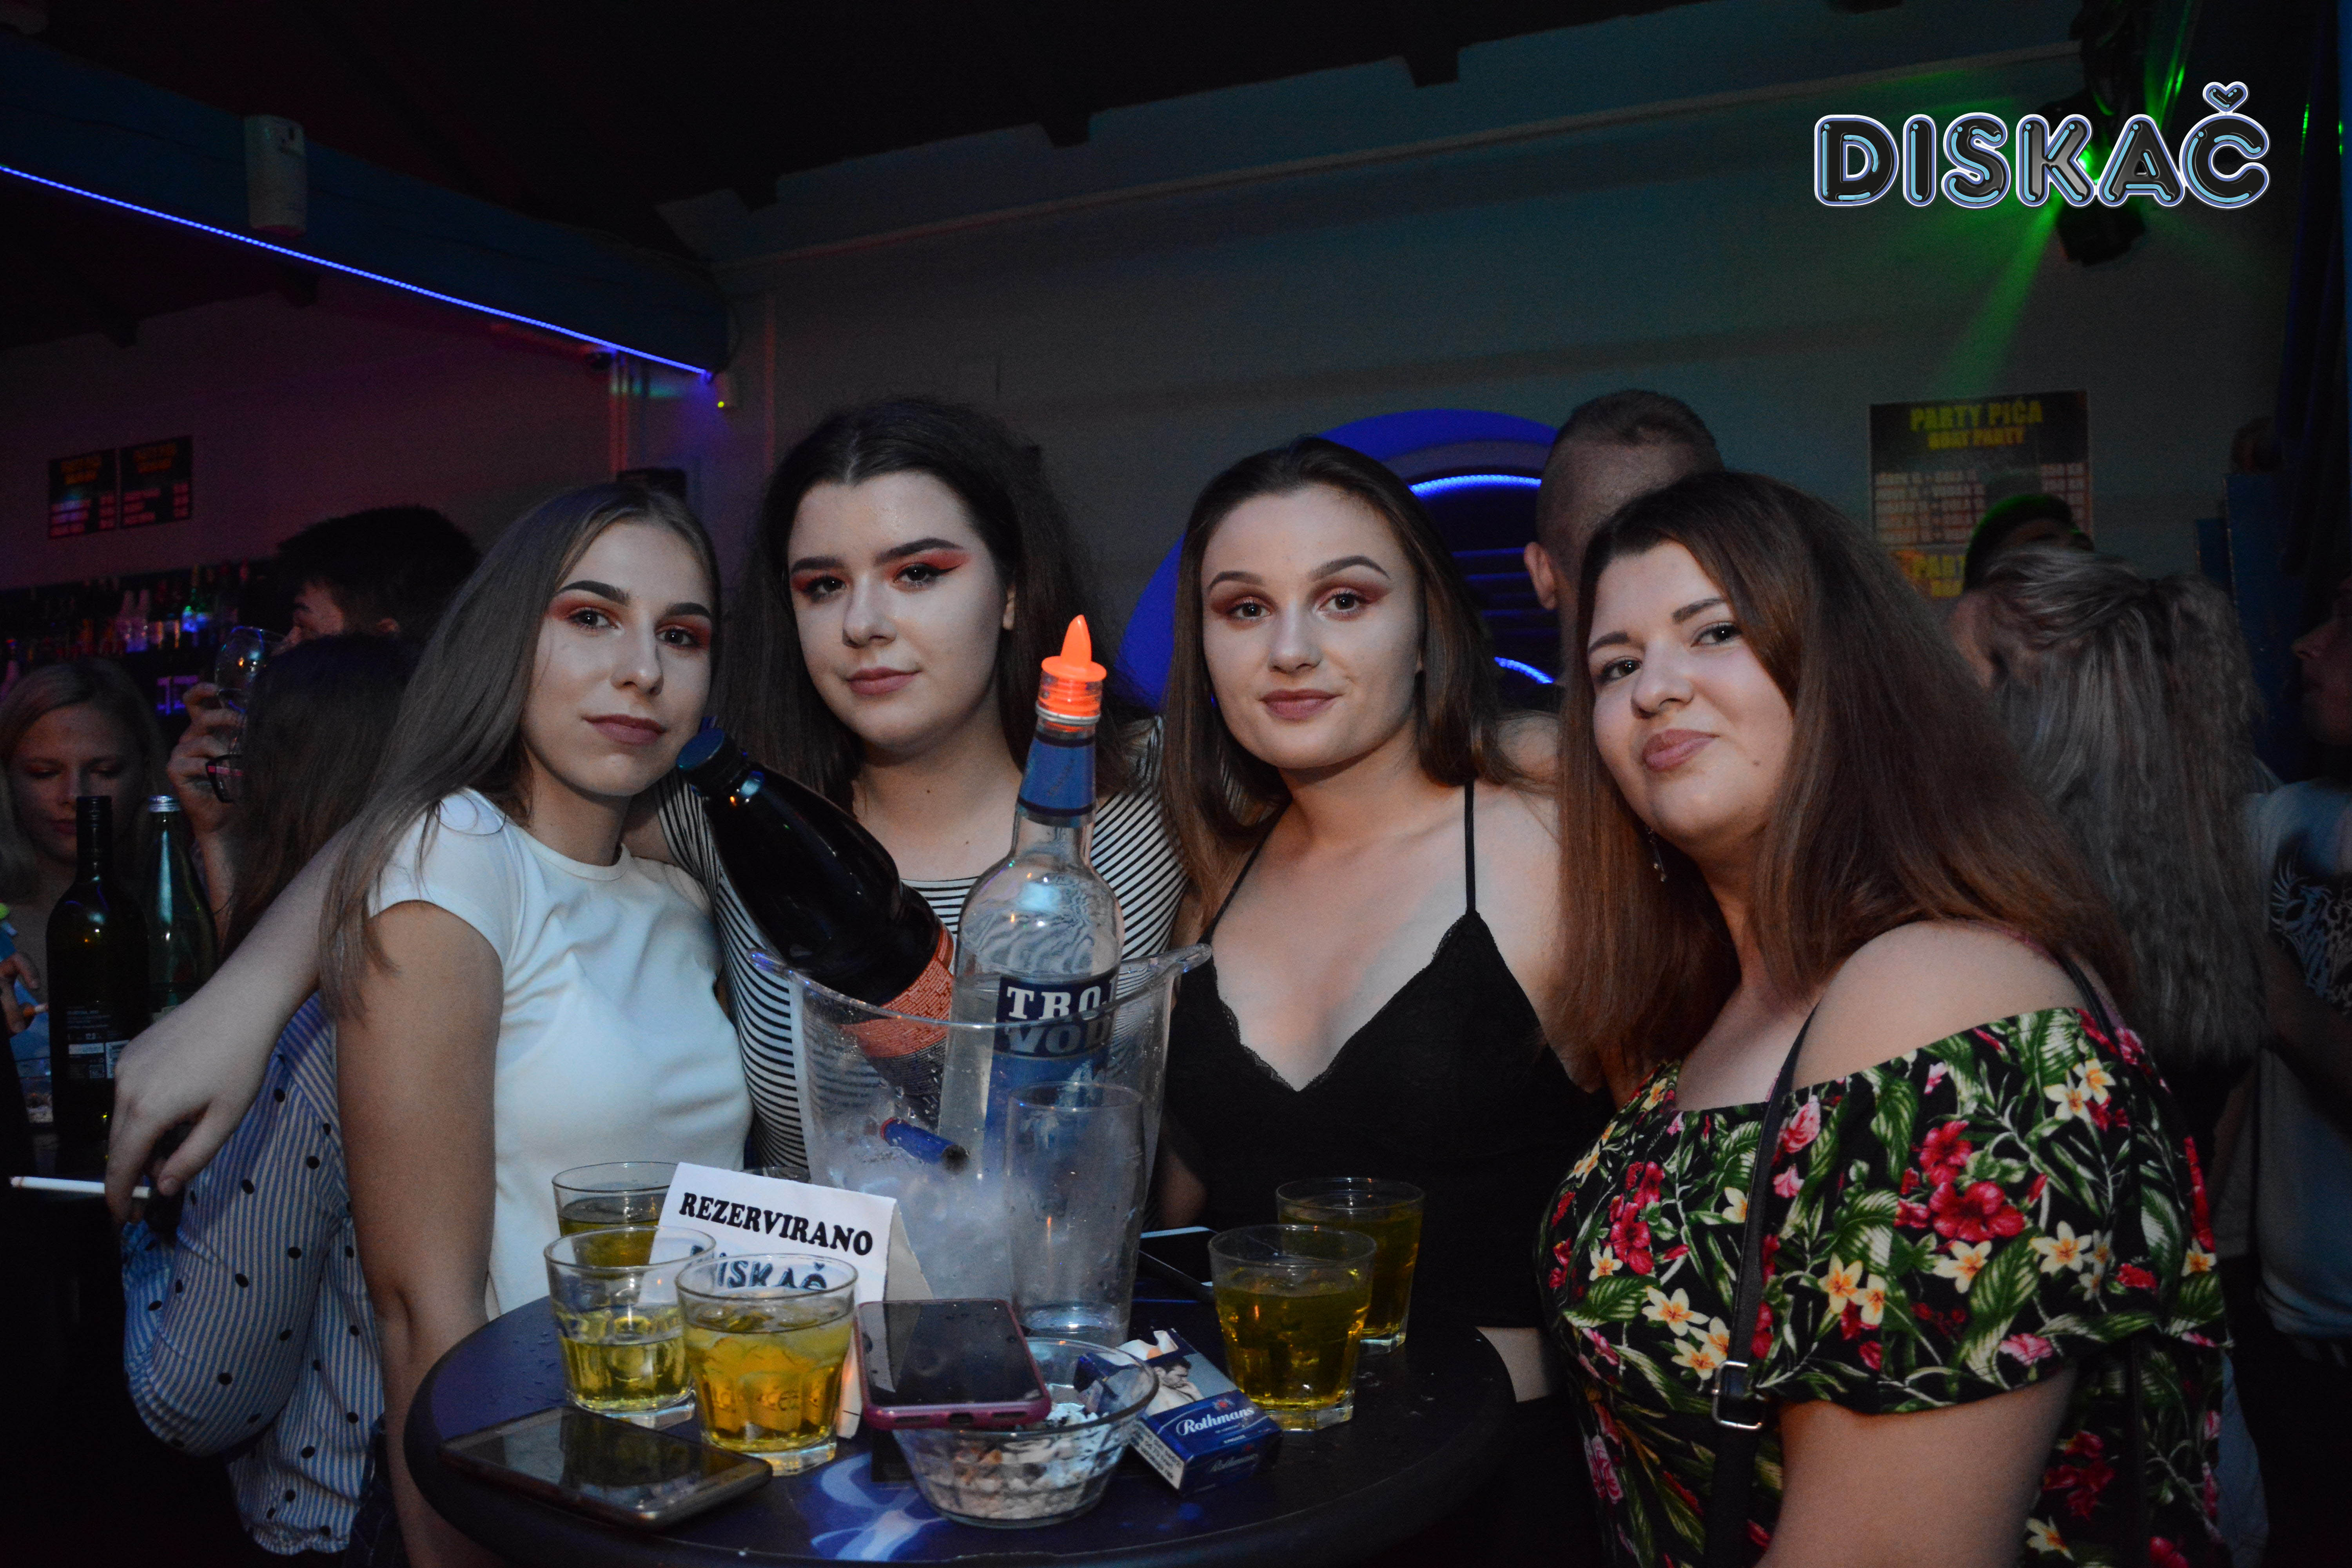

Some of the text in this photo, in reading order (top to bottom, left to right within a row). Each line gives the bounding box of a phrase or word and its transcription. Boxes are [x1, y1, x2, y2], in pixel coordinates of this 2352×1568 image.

[1911, 405, 1981, 431] PARTY
[679, 1192, 873, 1256] REZERVIRANO
[1176, 1408, 1255, 1436] Rothmans
